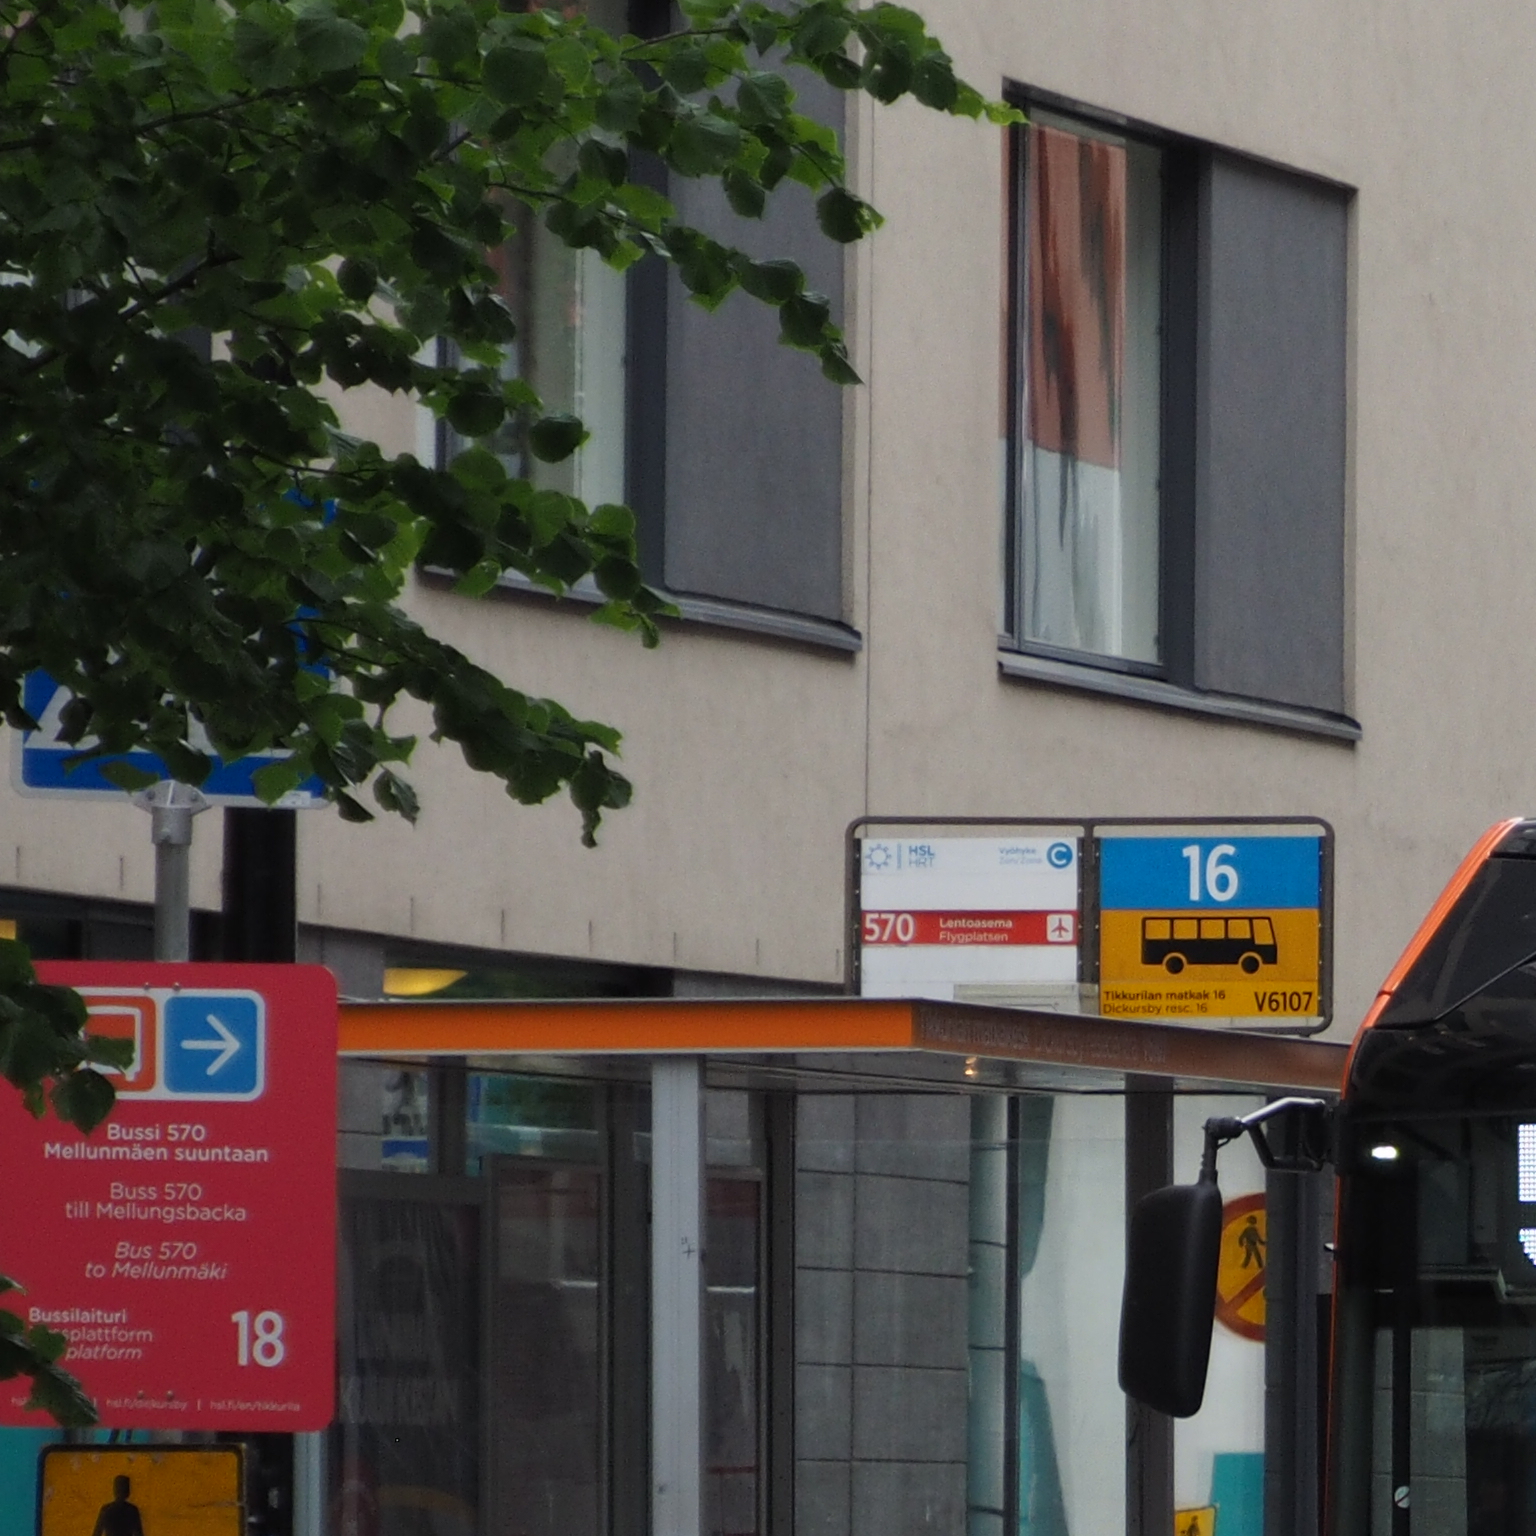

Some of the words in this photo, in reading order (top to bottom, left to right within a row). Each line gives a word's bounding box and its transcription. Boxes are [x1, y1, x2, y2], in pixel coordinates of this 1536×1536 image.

[908, 845, 935, 856] HSL
[908, 857, 934, 867] HRT
[1182, 844, 1239, 902] 16
[864, 913, 915, 942] 570
[939, 917, 1013, 929] Lentoasema
[939, 931, 1009, 943] Flygplatsen
[1103, 990, 1162, 1001] Tikkurilan
[1165, 989, 1210, 1000] matkak
[1213, 990, 1226, 1000] 16
[1254, 991, 1313, 1013] V6107
[1103, 1003, 1161, 1014] Dickursby
[1196, 1003, 1208, 1013] 16
[107, 1124, 160, 1141] Bussi
[167, 1124, 206, 1141] 570
[44, 1142, 168, 1160] Mellunmäen
[174, 1146, 269, 1162] suuntaan
[110, 1182, 157, 1200] Buss
[164, 1183, 202, 1200] 570
[65, 1202, 89, 1219] till
[96, 1202, 247, 1223] Mellungsbacka
[114, 1242, 152, 1259] Bus
[159, 1243, 197, 1260] 570
[85, 1262, 105, 1278] to
[112, 1262, 228, 1280] Mellunmäki
[29, 1307, 127, 1323] Bussilaituri
[231, 1310, 285, 1367] 18
[65, 1344, 143, 1361] platform
